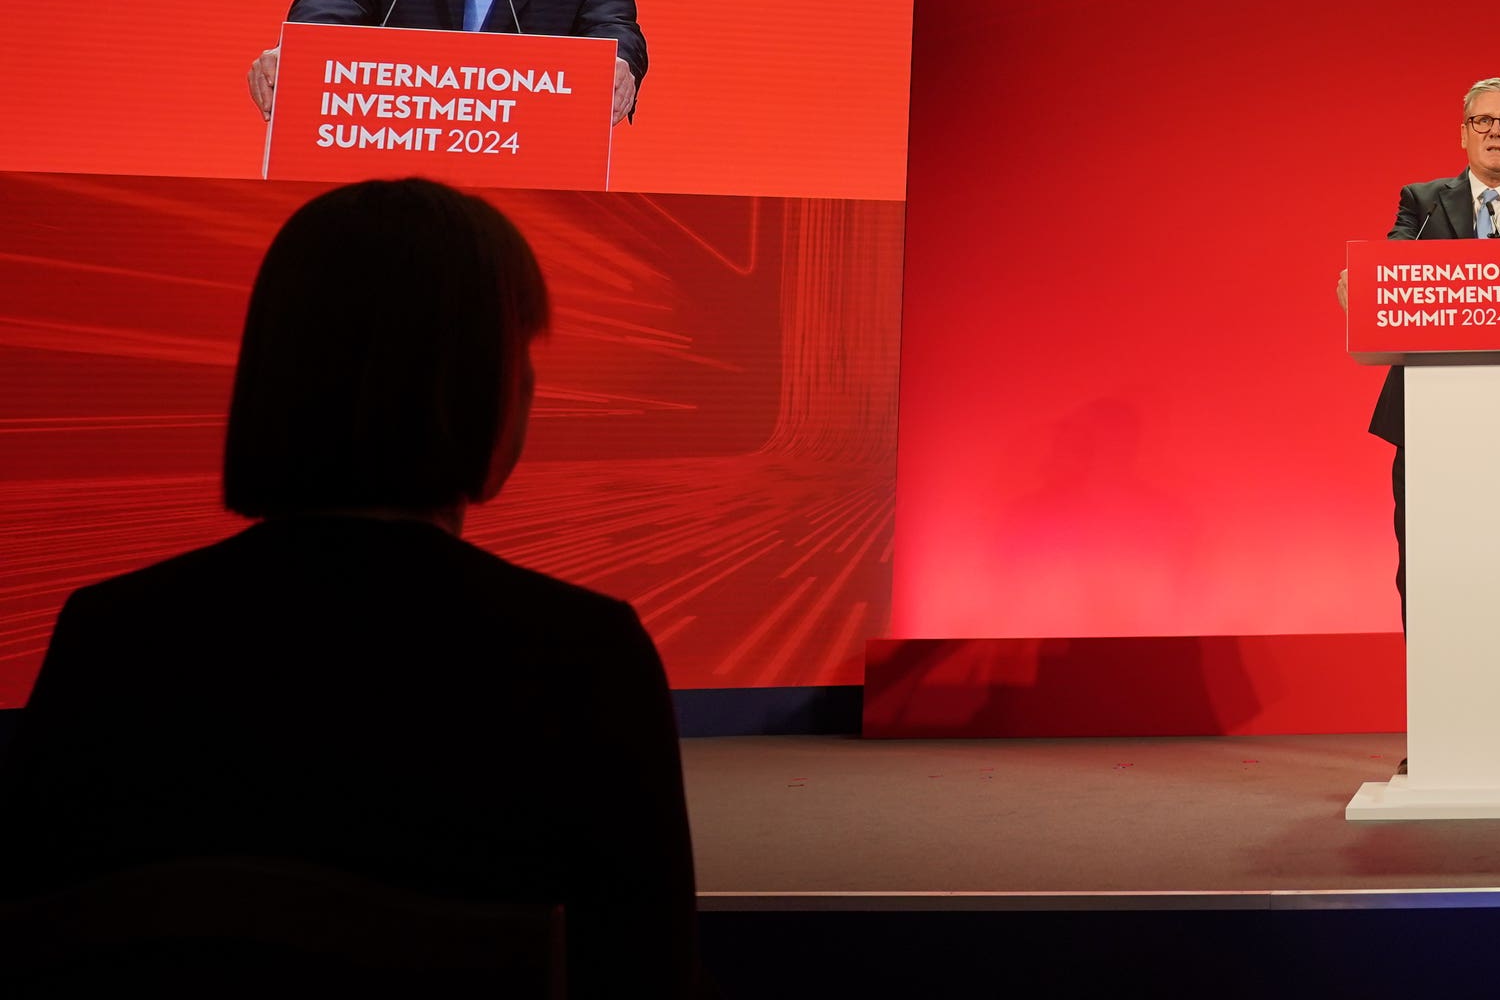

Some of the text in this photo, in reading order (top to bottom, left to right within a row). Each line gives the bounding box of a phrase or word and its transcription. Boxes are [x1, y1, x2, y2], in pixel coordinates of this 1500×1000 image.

[324, 60, 572, 95] INTERNATIONAL
[319, 91, 517, 124] INVESTMENT
[316, 123, 520, 156] SUMMIT 2024
[1375, 308, 1458, 329] SUMMIT
